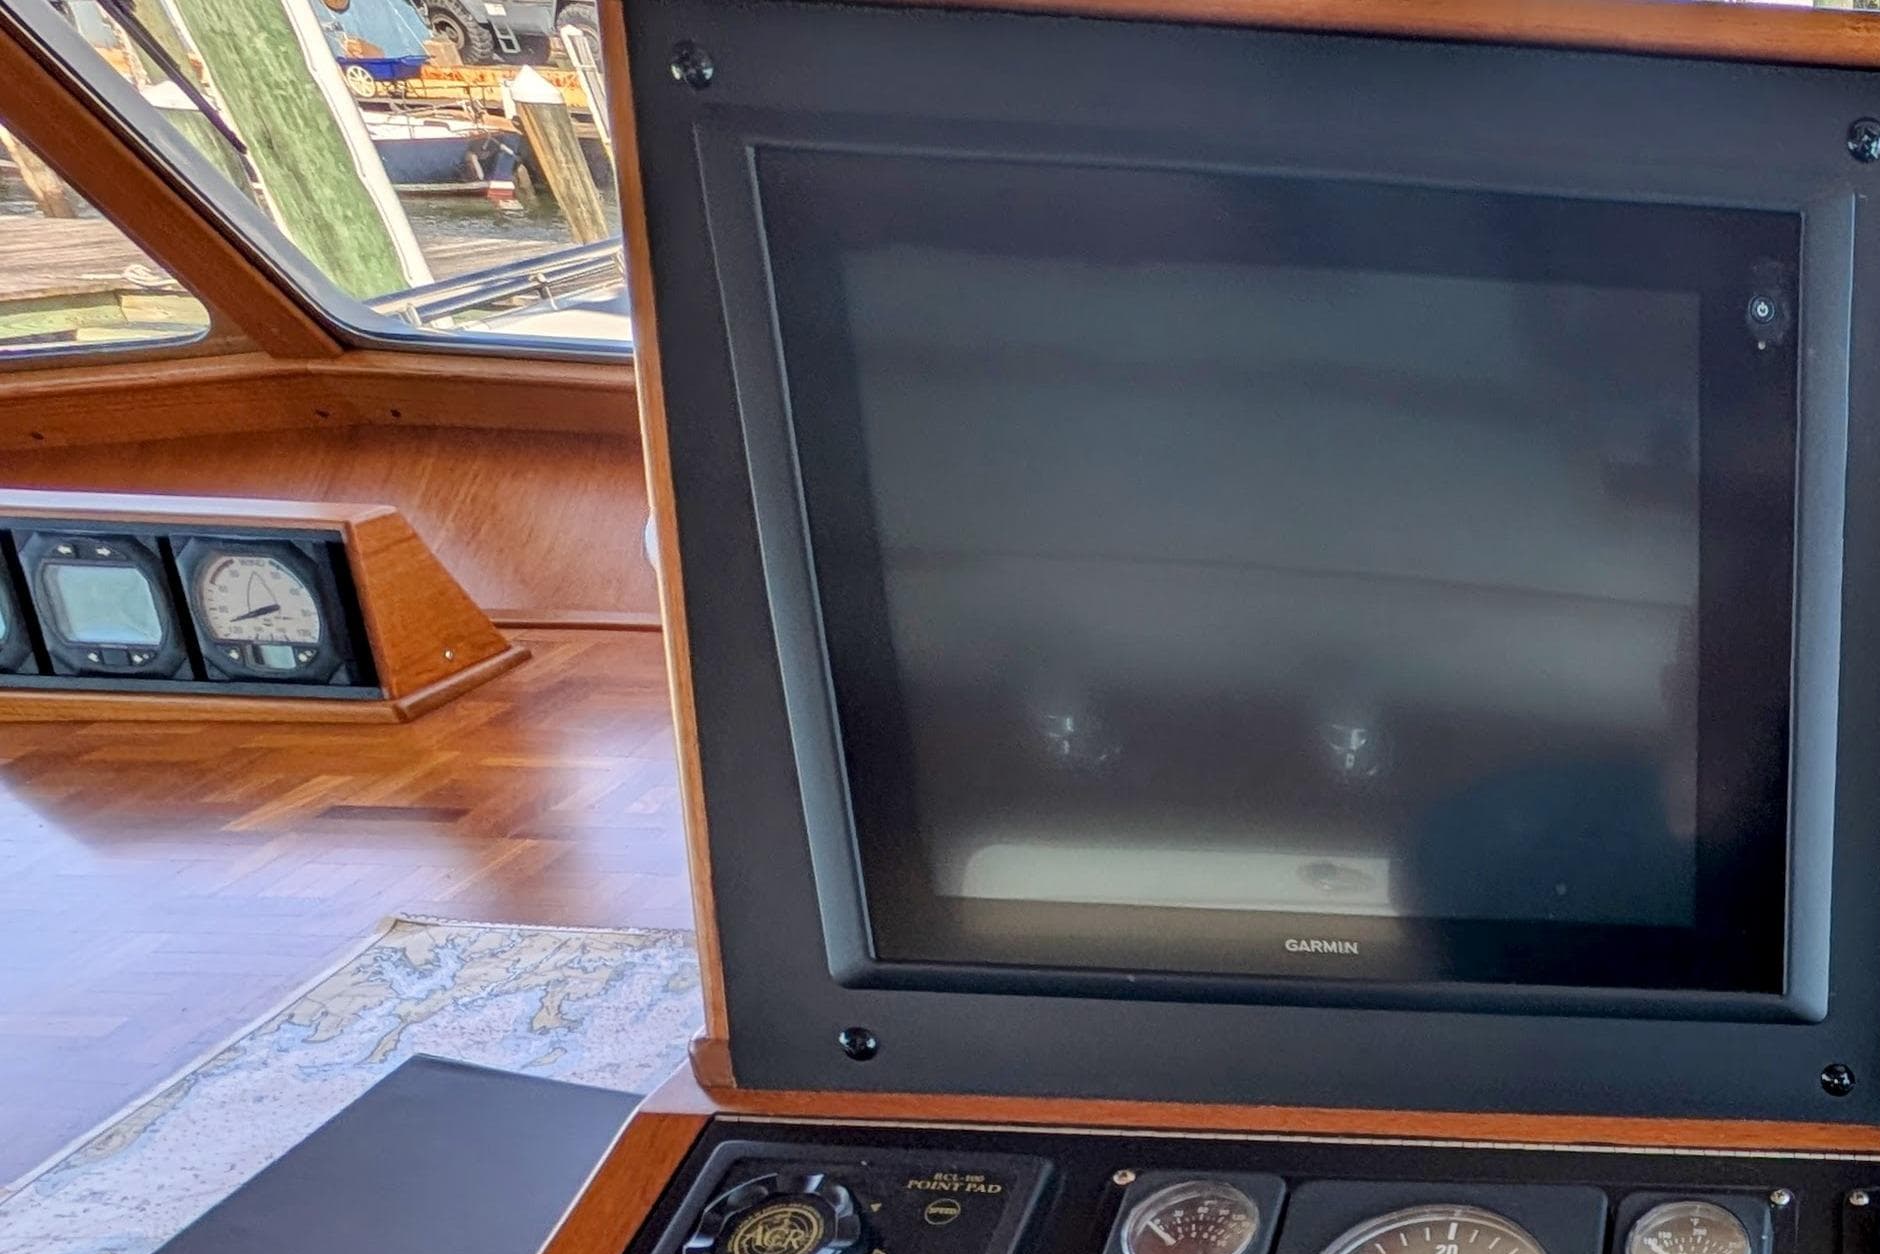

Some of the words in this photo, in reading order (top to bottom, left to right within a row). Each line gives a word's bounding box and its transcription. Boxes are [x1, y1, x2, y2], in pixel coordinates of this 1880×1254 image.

[1284, 939, 1359, 955] GARMIN
[907, 1180, 960, 1191] POINT
[965, 1183, 1002, 1193] PAD
